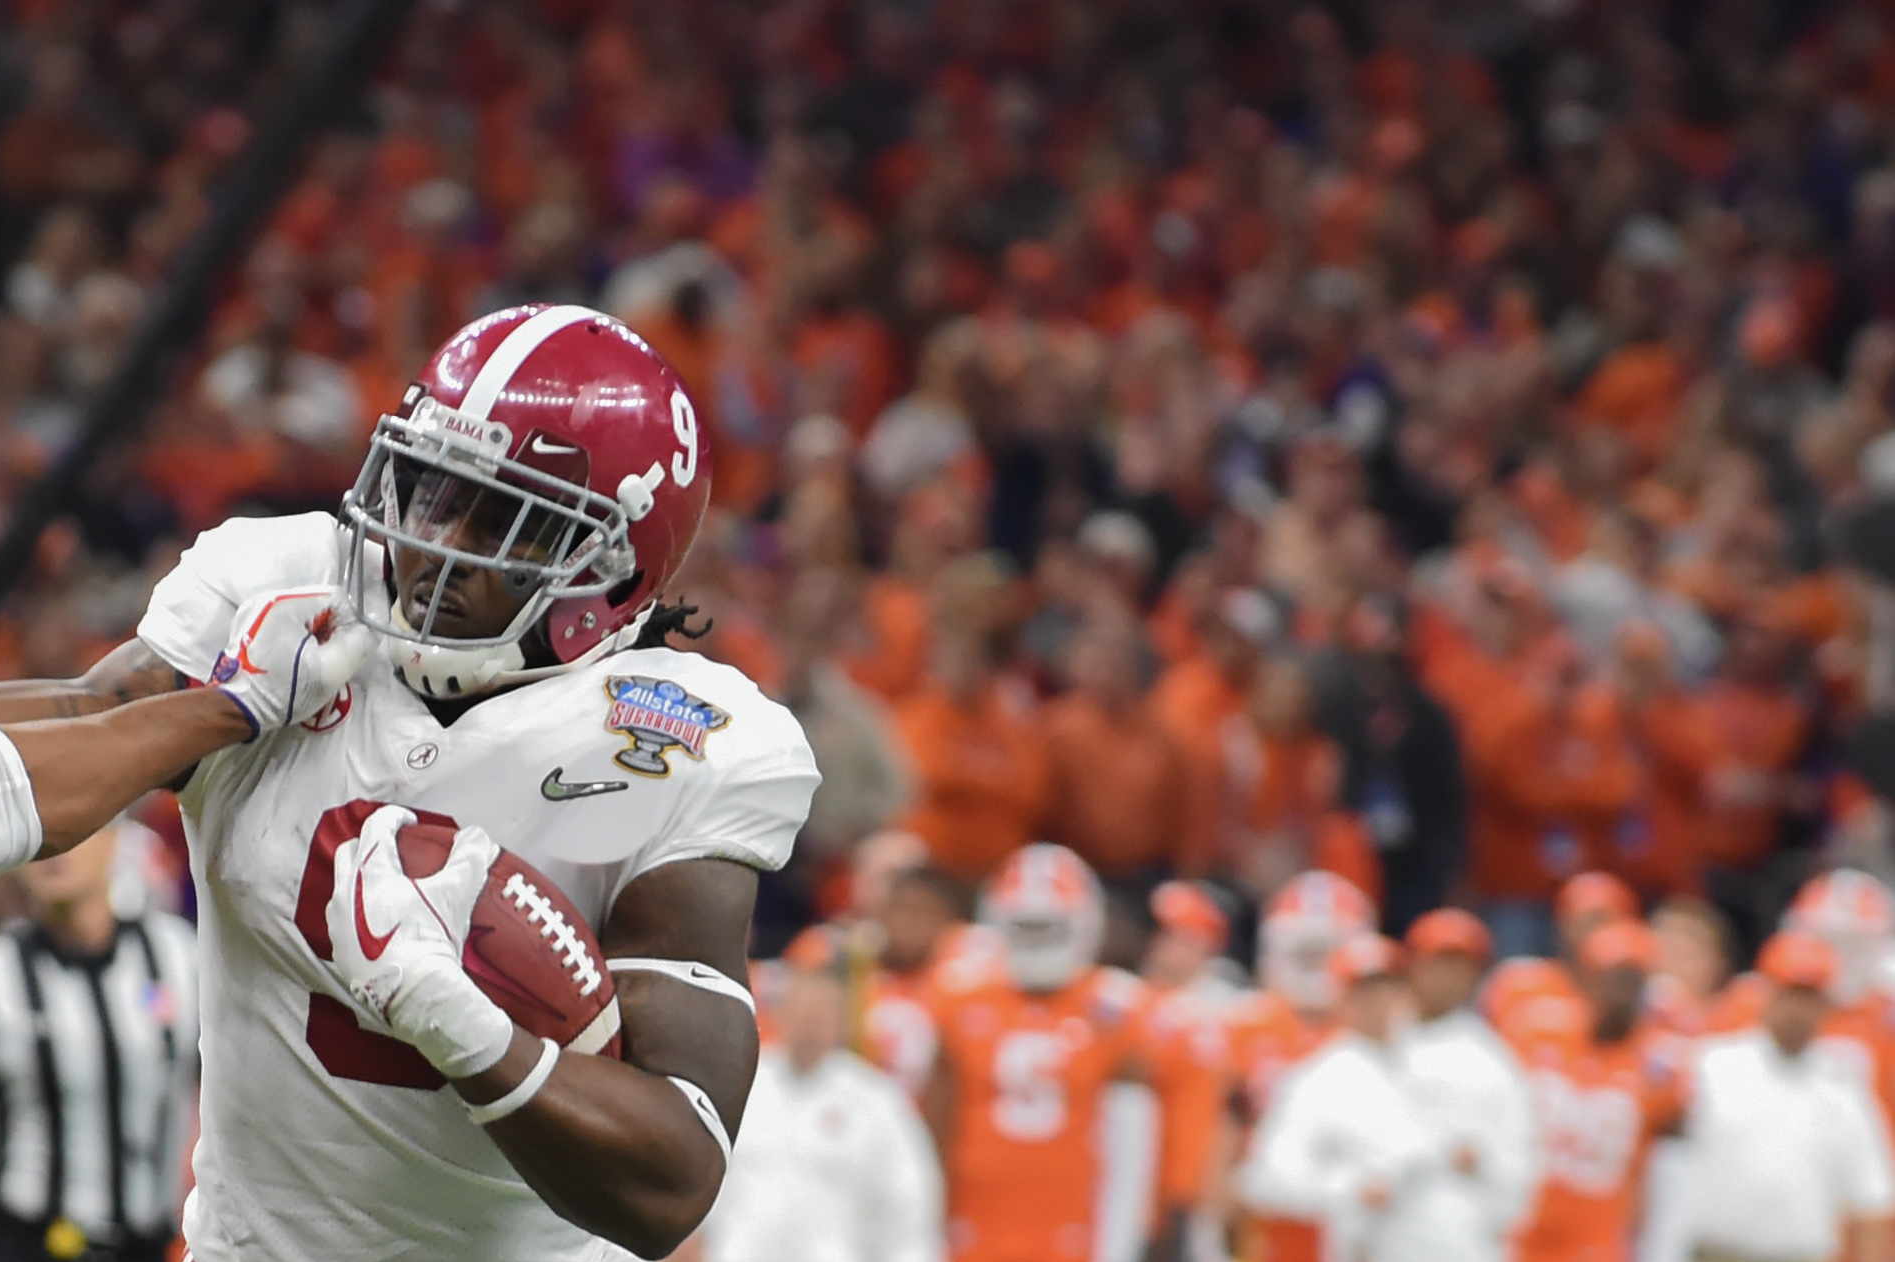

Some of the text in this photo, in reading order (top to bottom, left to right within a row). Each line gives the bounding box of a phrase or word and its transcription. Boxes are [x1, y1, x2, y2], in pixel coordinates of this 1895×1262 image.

[445, 416, 484, 442] BAMA
[670, 390, 698, 488] 9
[621, 686, 705, 721] Allstate
